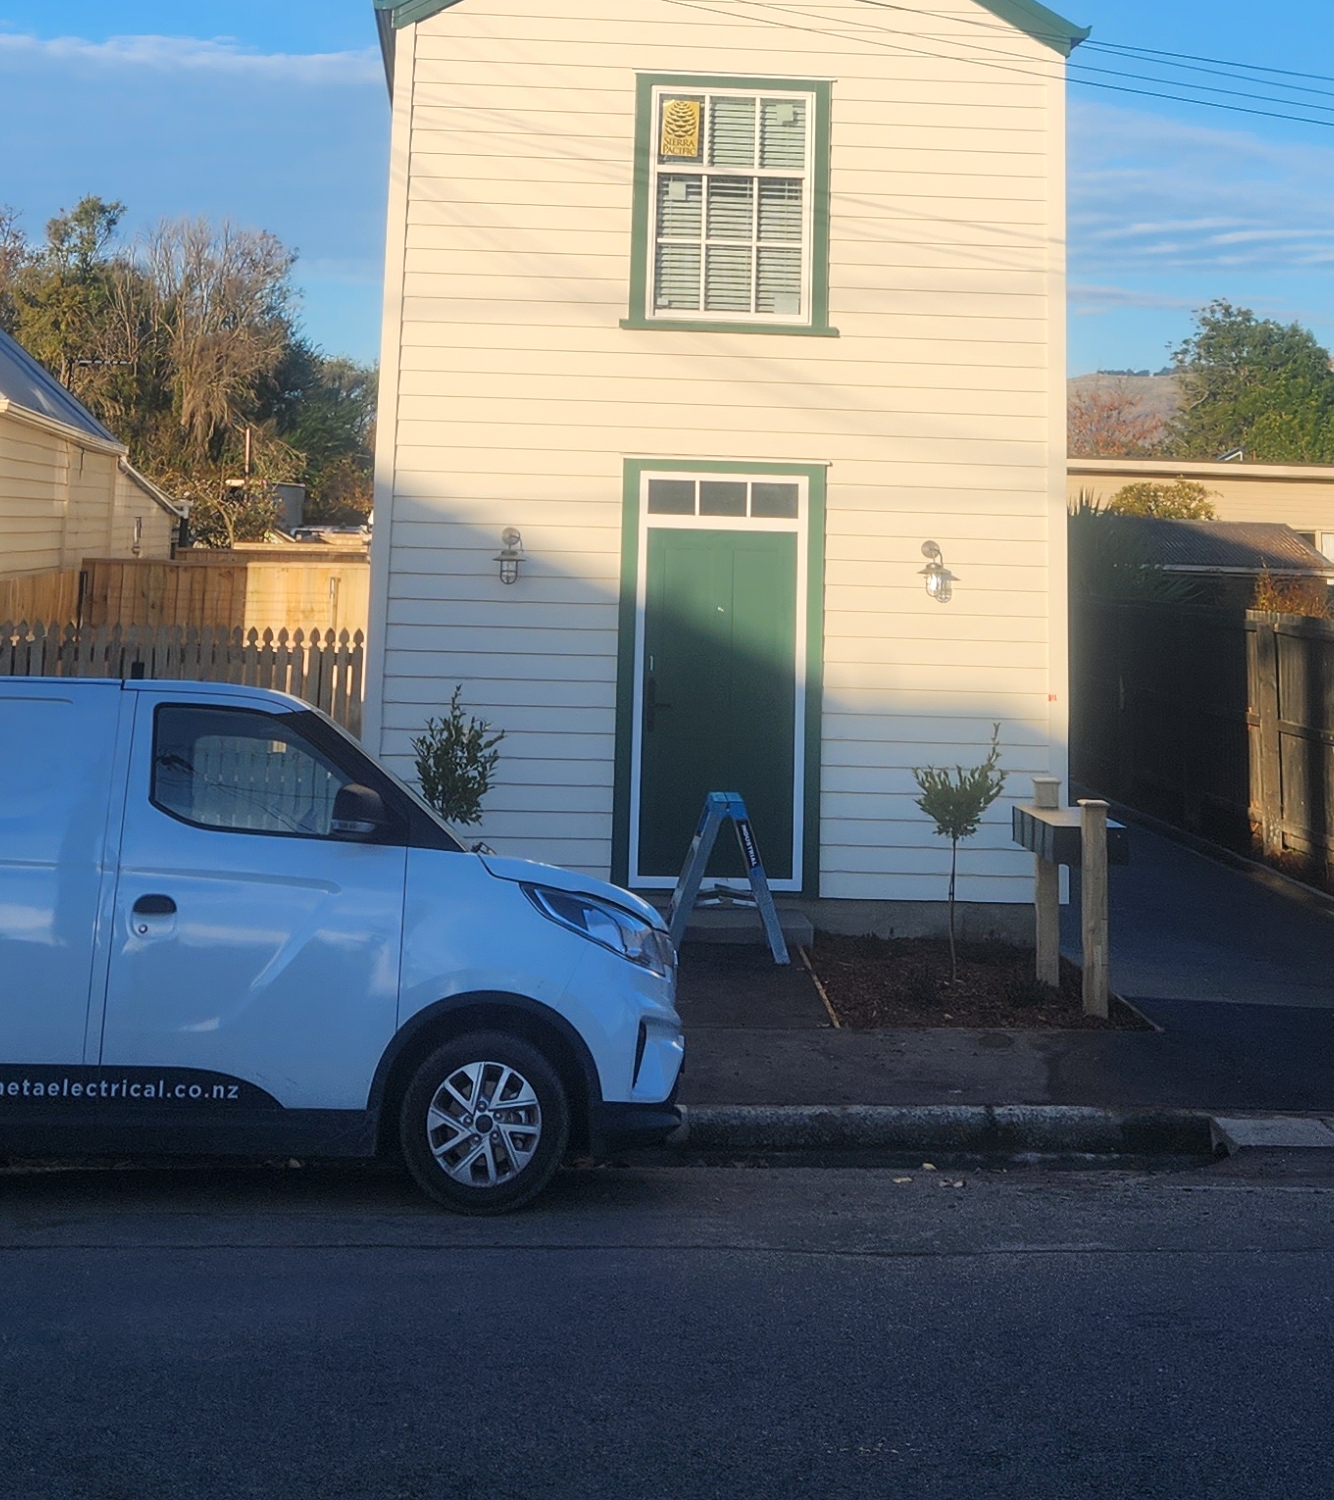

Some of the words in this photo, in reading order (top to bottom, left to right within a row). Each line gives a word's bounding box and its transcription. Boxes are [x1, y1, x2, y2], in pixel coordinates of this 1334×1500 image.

[664, 137, 695, 147] SIERRA
[663, 145, 696, 155] PACIFIC
[741, 824, 757, 867] INDUSTRIAL
